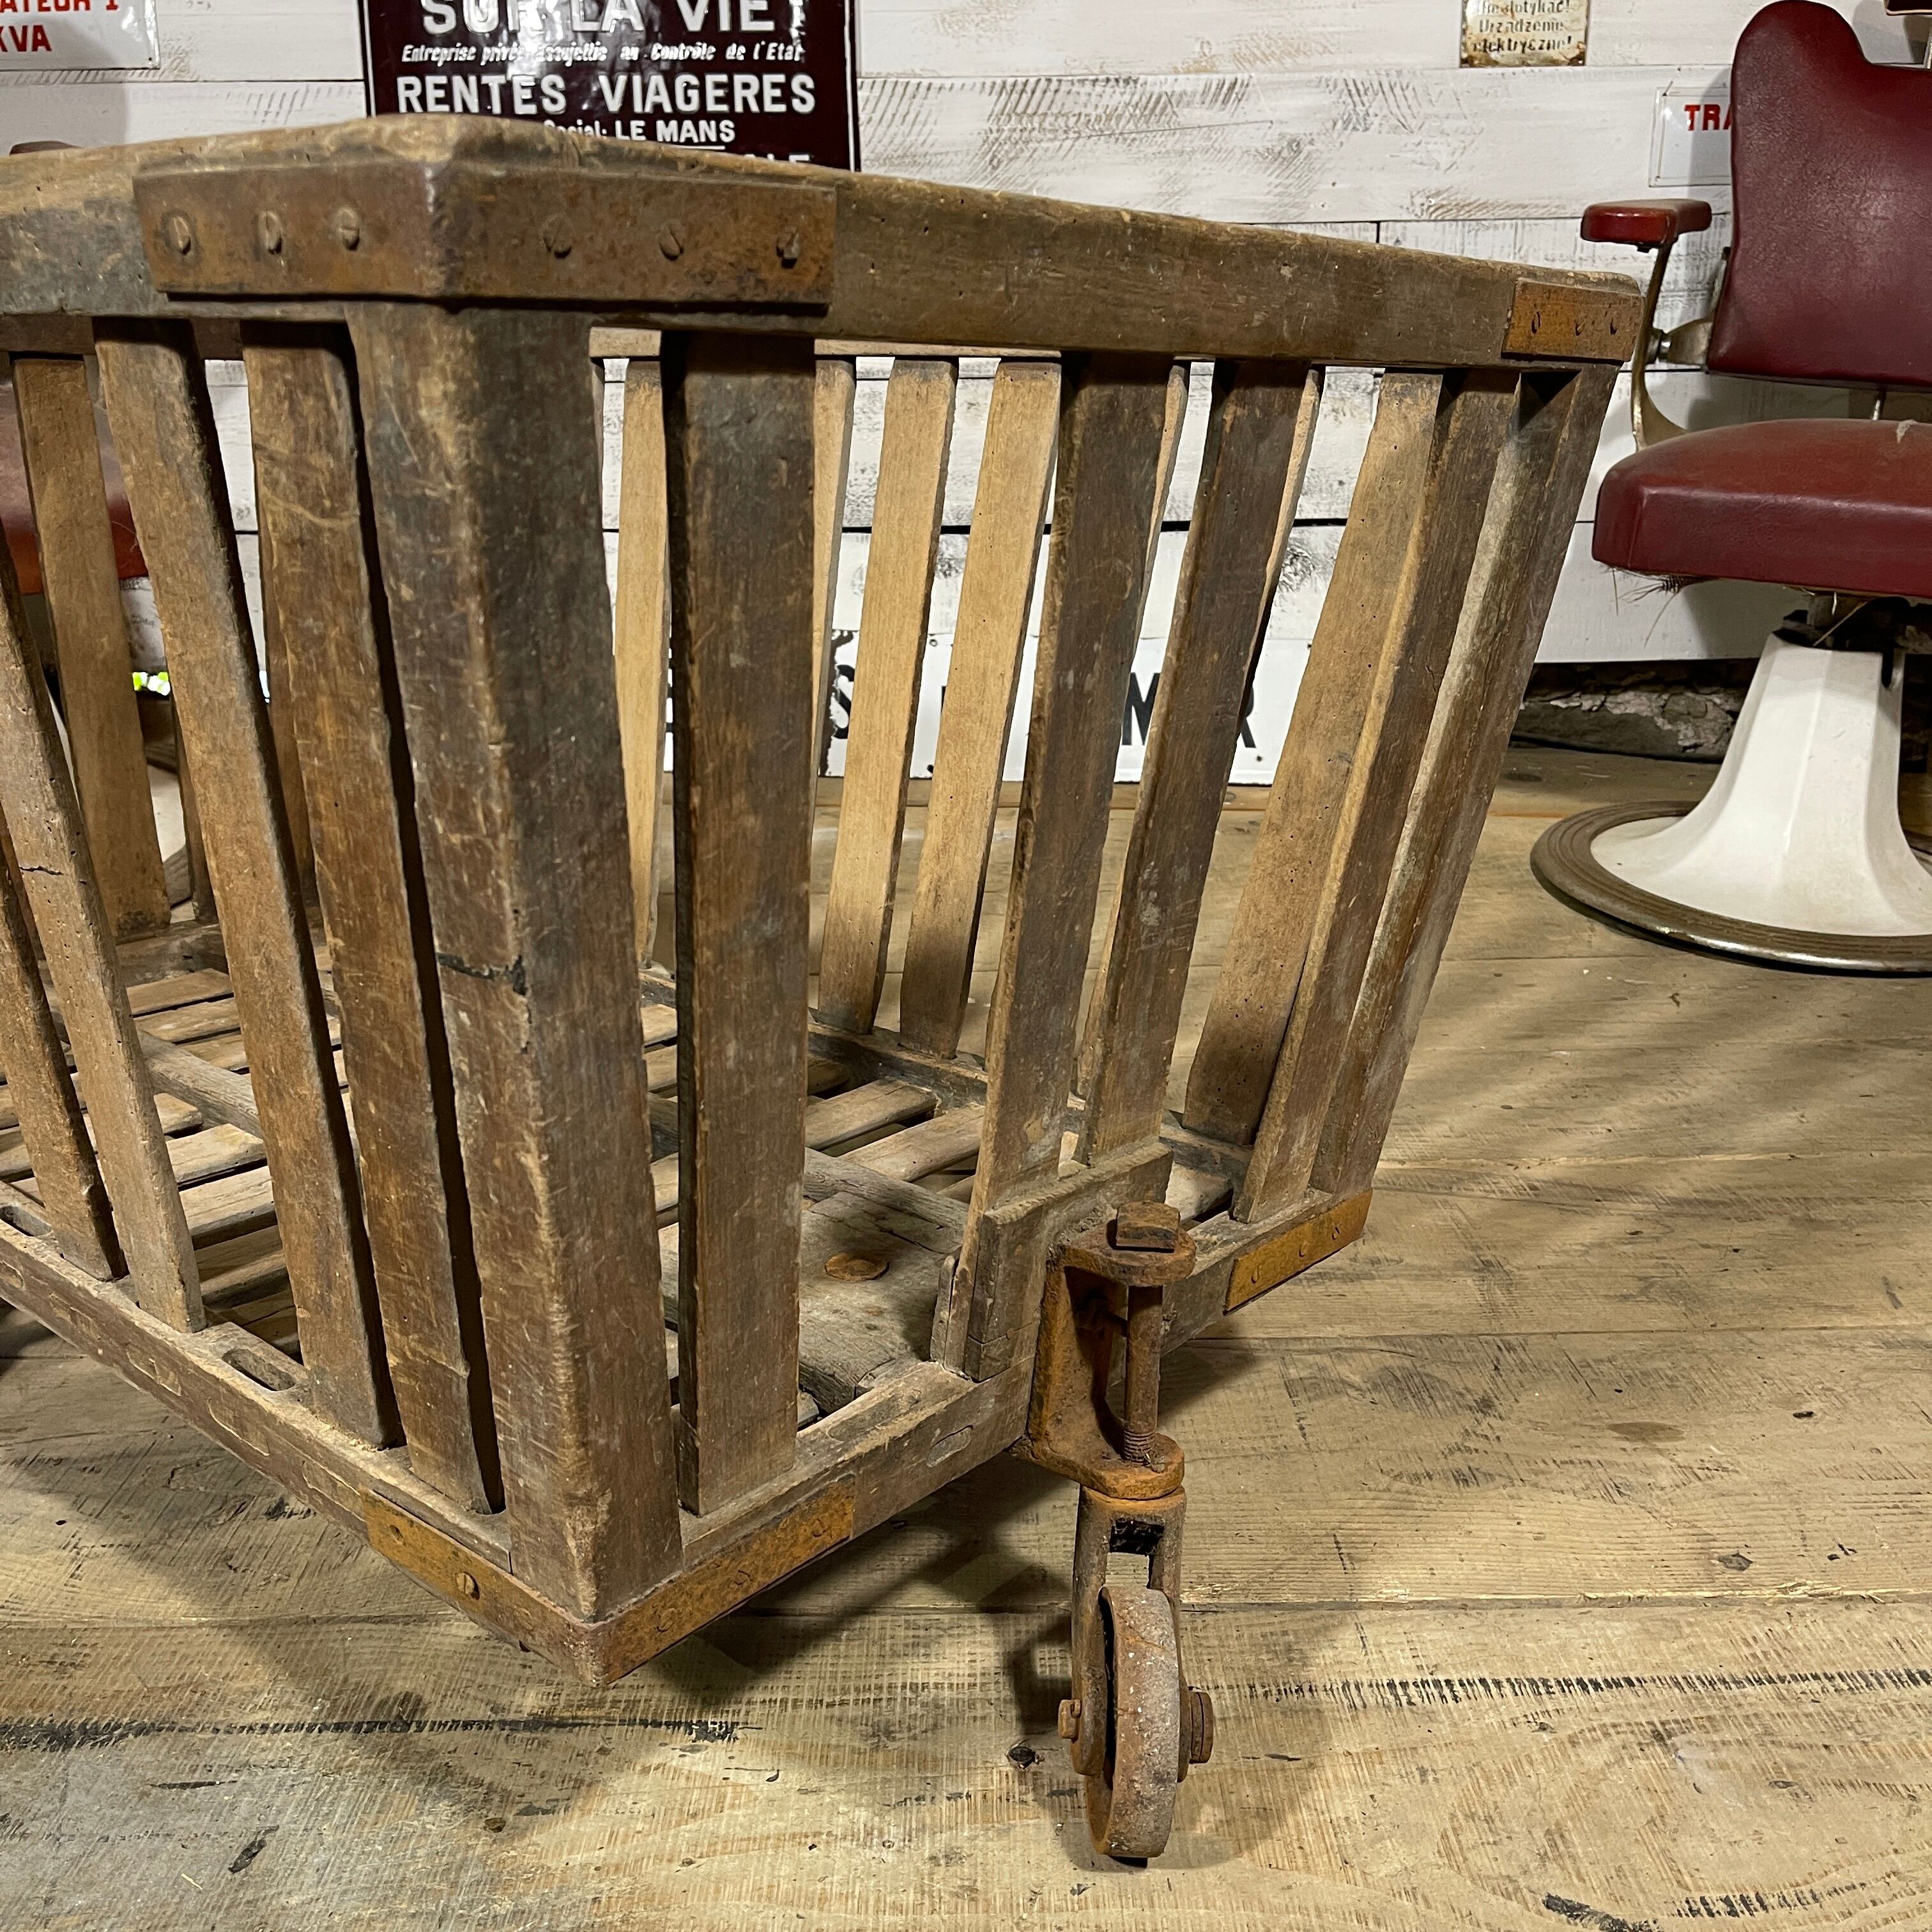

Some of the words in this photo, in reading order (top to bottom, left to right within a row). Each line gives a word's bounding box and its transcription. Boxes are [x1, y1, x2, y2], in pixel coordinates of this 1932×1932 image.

[572, 0, 645, 32] LA
[678, 0, 775, 31] VIE
[402, 43, 477, 66] Entreprise
[650, 41, 716, 61] Contrôle
[725, 43, 747, 61] de
[397, 74, 567, 115] RENTES
[597, 73, 816, 114] VIAGERES
[615, 119, 647, 141] LE
[656, 119, 736, 143] MANS
